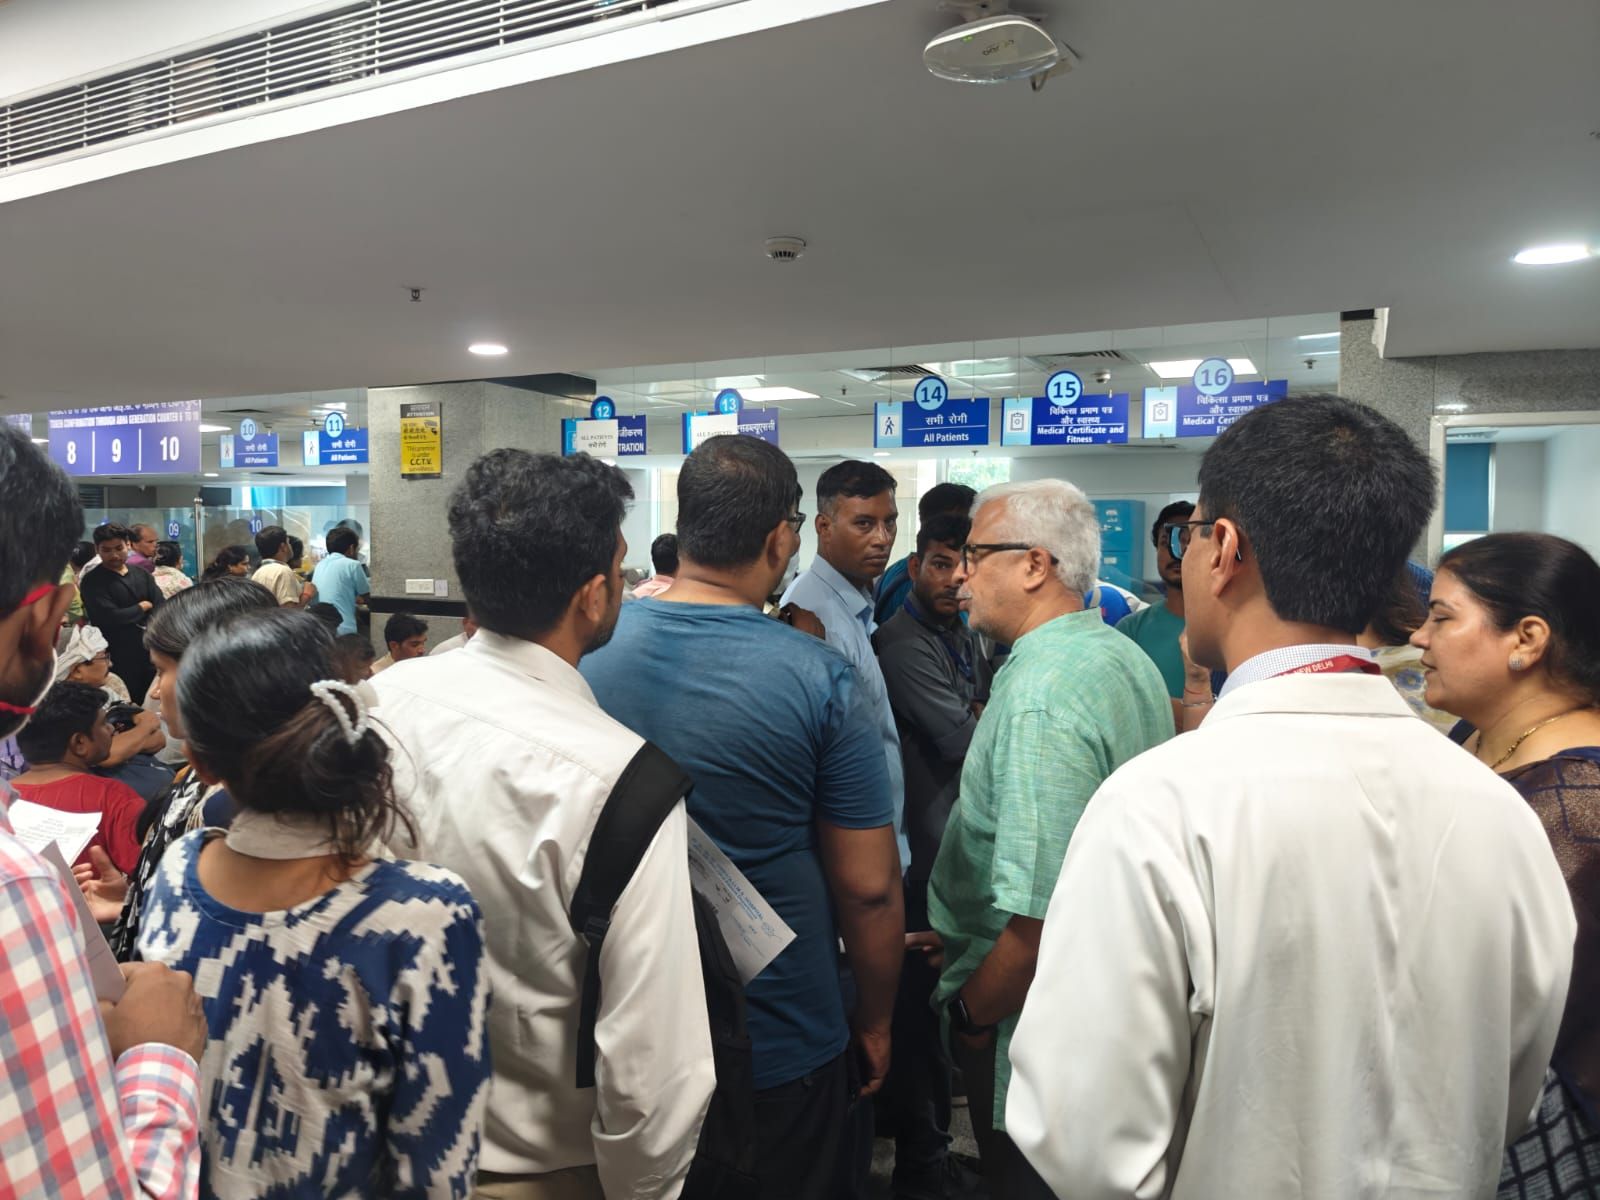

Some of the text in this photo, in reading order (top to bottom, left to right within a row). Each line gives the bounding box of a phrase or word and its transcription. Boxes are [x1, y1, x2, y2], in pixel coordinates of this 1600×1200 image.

[1201, 368, 1227, 387] 16
[920, 386, 942, 403] 14
[1053, 381, 1076, 398] 15
[597, 405, 609, 417] 12
[722, 398, 737, 412] 13
[948, 412, 968, 424] रोगी
[1183, 417, 1215, 426] Medical
[243, 424, 254, 436] 10
[329, 420, 340, 431] 11
[1068, 426, 1106, 434] Certificate
[1109, 425, 1124, 433] and
[923, 432, 969, 443] All Patients
[1066, 435, 1093, 443] Fitness
[66, 440, 77, 465] 8
[111, 438, 122, 463] 9
[160, 435, 180, 461] 10
[618, 442, 645, 452] TRATION
[168, 523, 179, 536] 09
[250, 519, 262, 533] 10
[1312, 660, 1334, 672] DELHI
